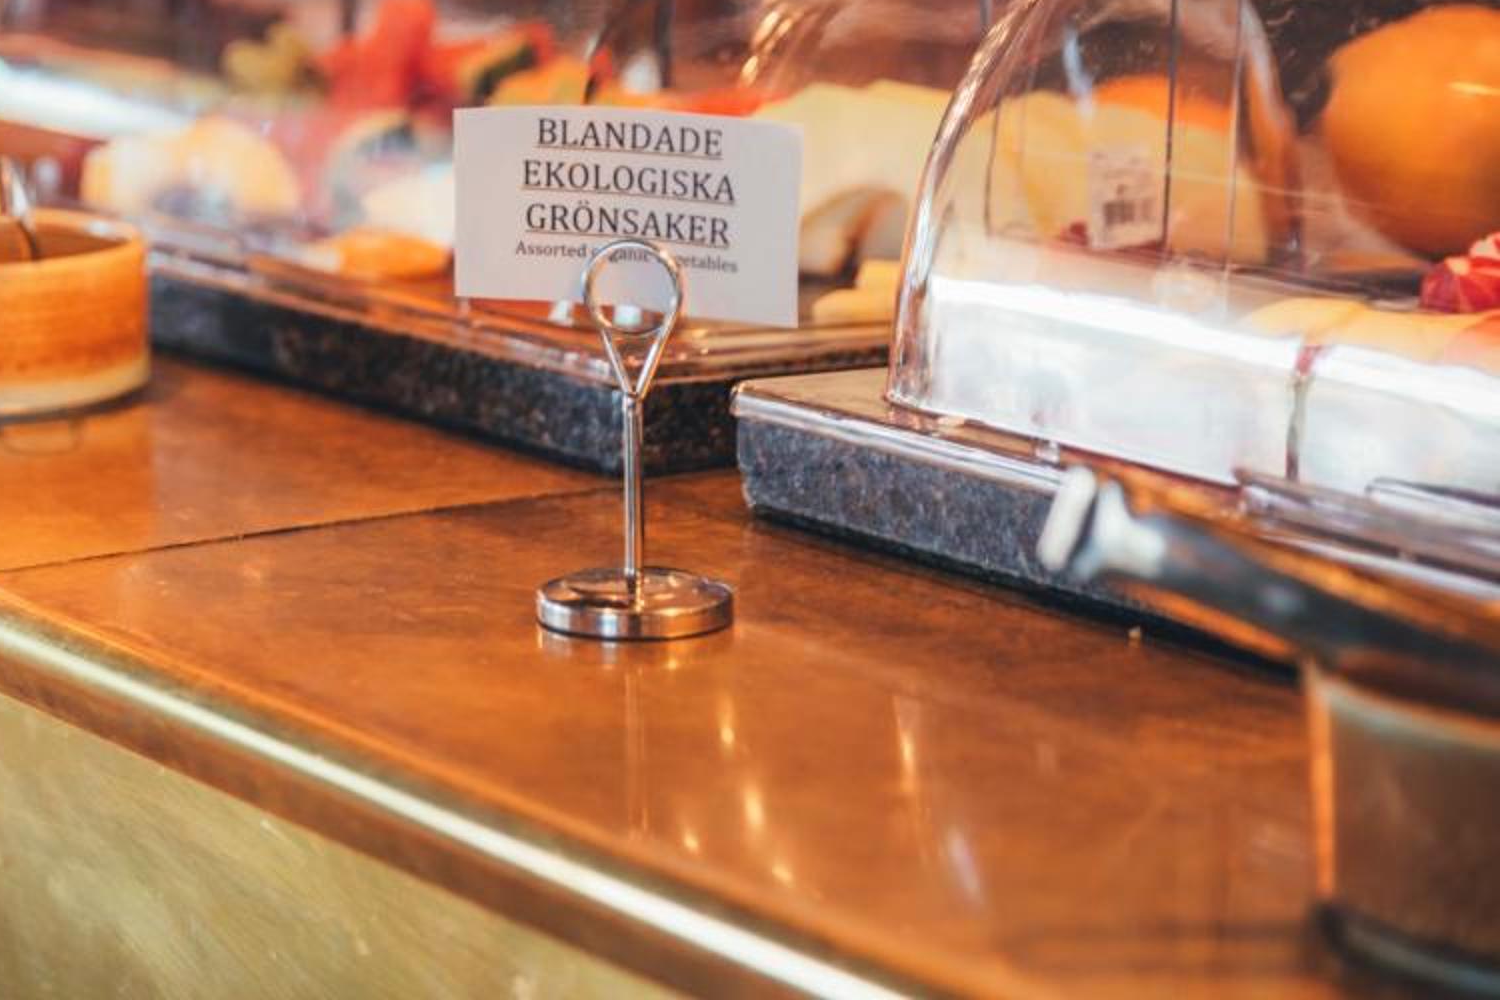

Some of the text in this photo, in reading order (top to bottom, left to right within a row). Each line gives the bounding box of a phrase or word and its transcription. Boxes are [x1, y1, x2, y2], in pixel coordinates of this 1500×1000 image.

[538, 117, 724, 157] BLANDADE
[523, 159, 736, 202] EKOLOGISKA
[526, 201, 731, 245] GRÖNSAKER
[516, 240, 587, 258] Assorted
